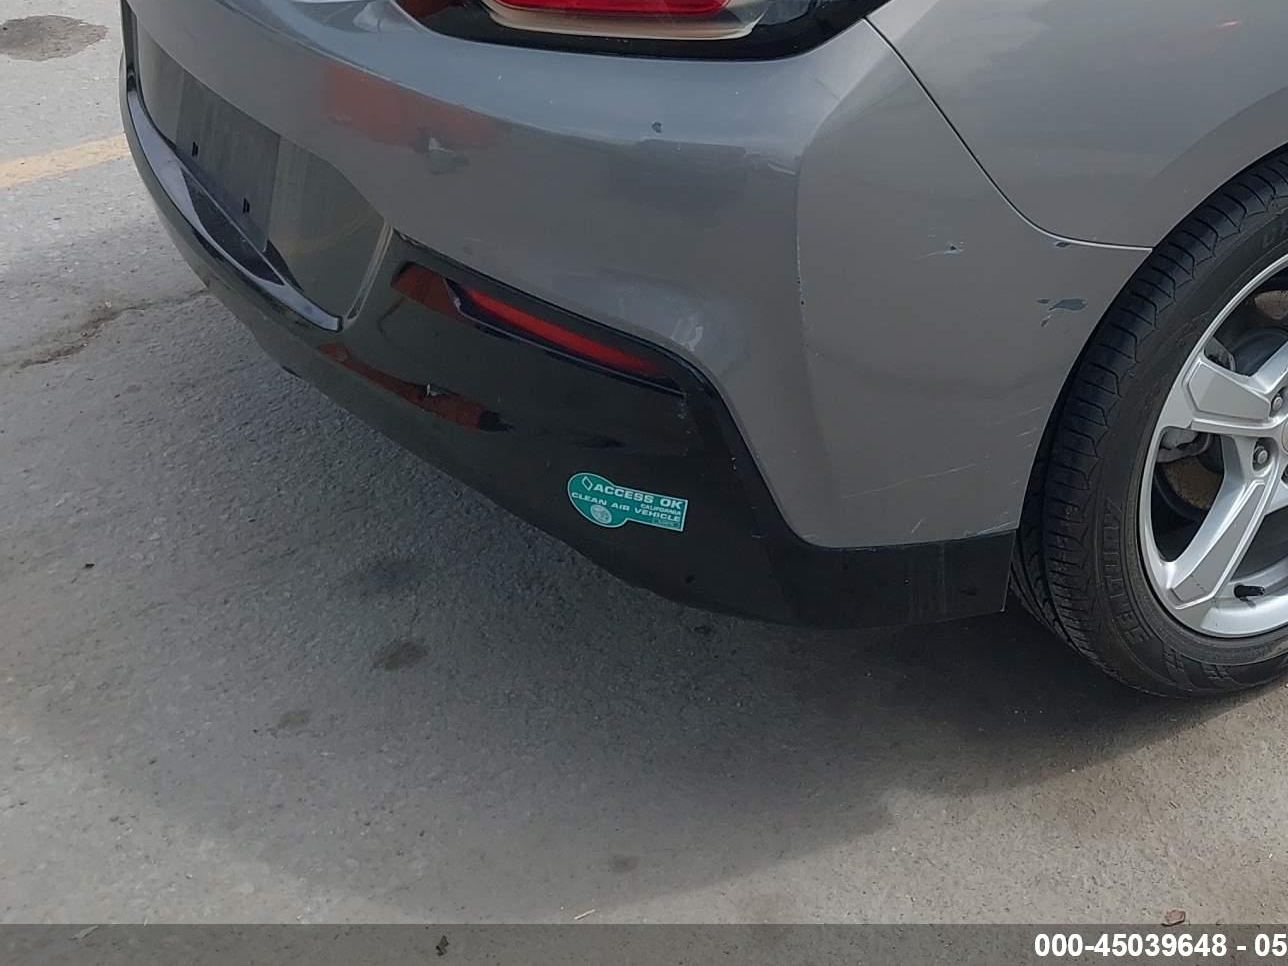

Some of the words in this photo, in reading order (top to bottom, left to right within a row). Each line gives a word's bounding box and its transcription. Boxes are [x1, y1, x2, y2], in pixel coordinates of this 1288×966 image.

[571, 492, 608, 506] CLEAN
[611, 502, 630, 511] AIR
[634, 507, 681, 522] VEHICLE
[593, 483, 654, 503] ACCESS
[659, 497, 683, 510] OK
[640, 503, 682, 516] CALIFORNIA
